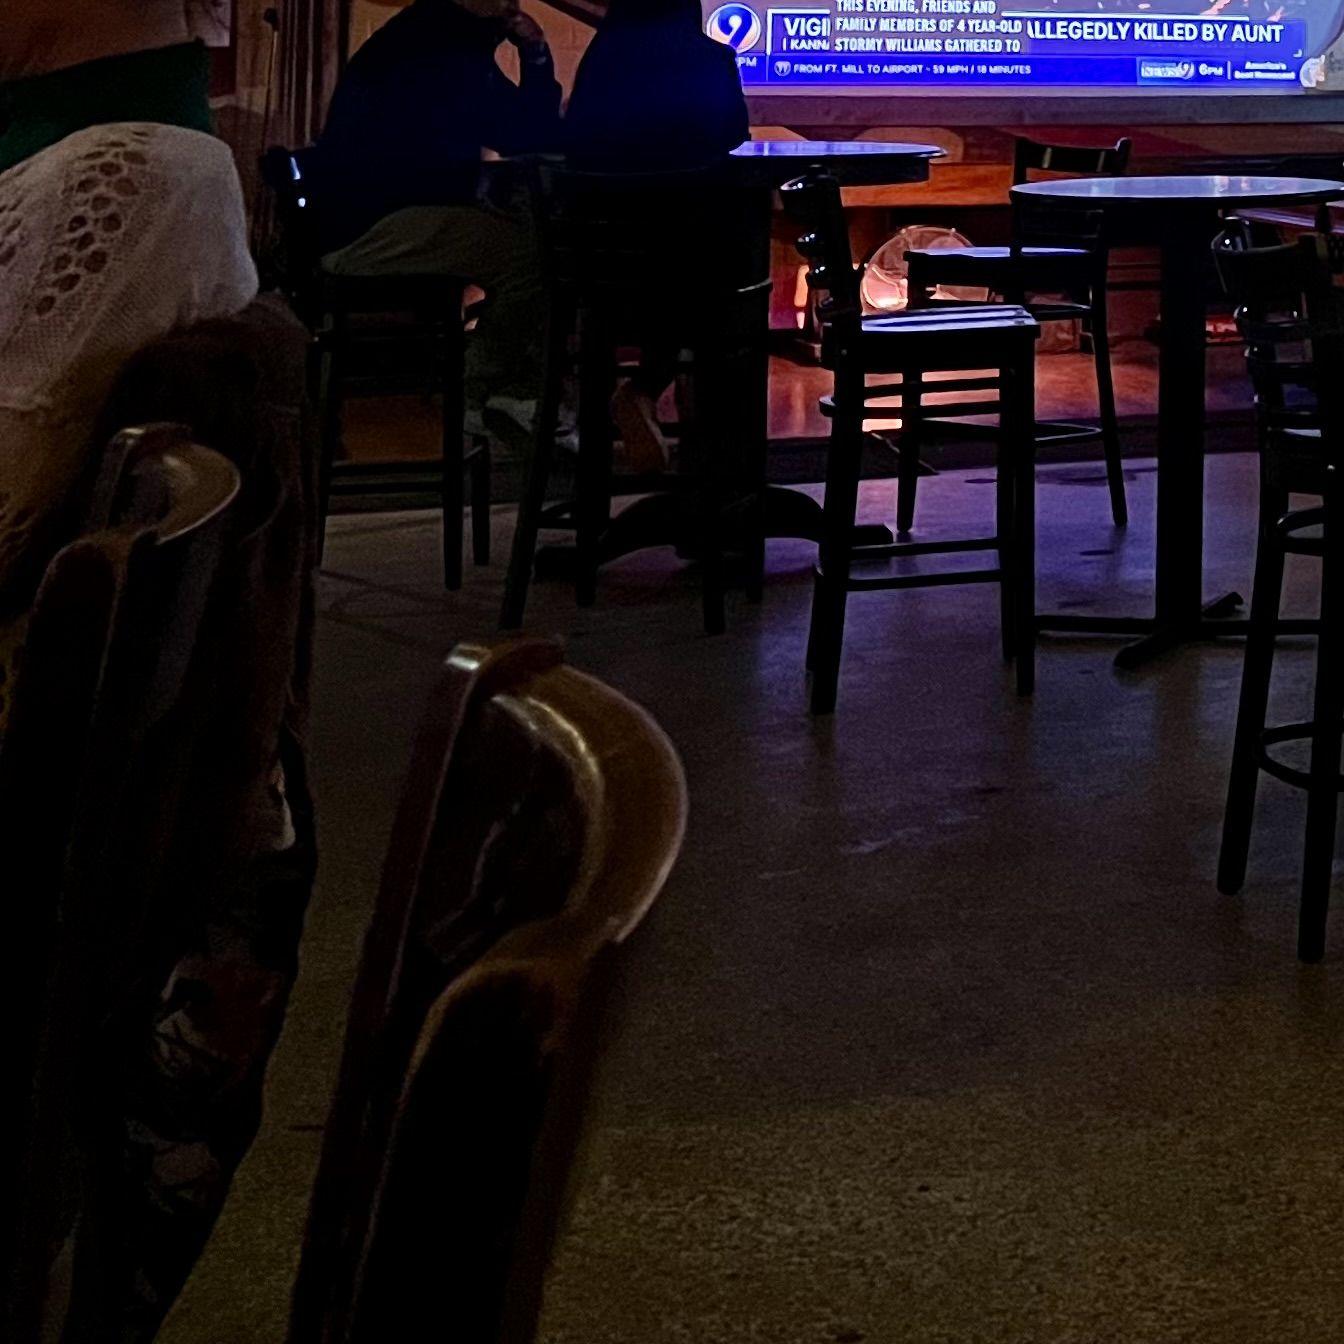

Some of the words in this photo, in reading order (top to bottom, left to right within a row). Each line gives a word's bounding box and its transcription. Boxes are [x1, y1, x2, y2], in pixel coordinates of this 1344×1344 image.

[836, 0, 863, 13] THIS
[866, 0, 919, 14] EVENING,
[921, 0, 971, 14] FRIENDS
[972, 0, 995, 14] AND
[836, 19, 875, 32] FAMILY
[879, 19, 936, 32] MEMBERS
[939, 19, 954, 32] OF
[957, 19, 966, 32] 4
[967, 20, 1022, 33] YEAR-OLD
[1134, 20, 1198, 42] KILLED
[1201, 23, 1226, 42] BY
[1231, 24, 1284, 43] AUNT
[835, 38, 882, 53] STORMY
[886, 38, 943, 53] WILLIAMS
[945, 39, 1003, 53] GATHERED
[1005, 39, 1021, 53] TO
[794, 64, 823, 74] FROM
[841, 64, 864, 74] MILL
[867, 64, 880, 74] TO
[882, 64, 923, 74] AIRPORT
[946, 64, 969, 74] MPH
[989, 64, 1031, 74] MINUTES
